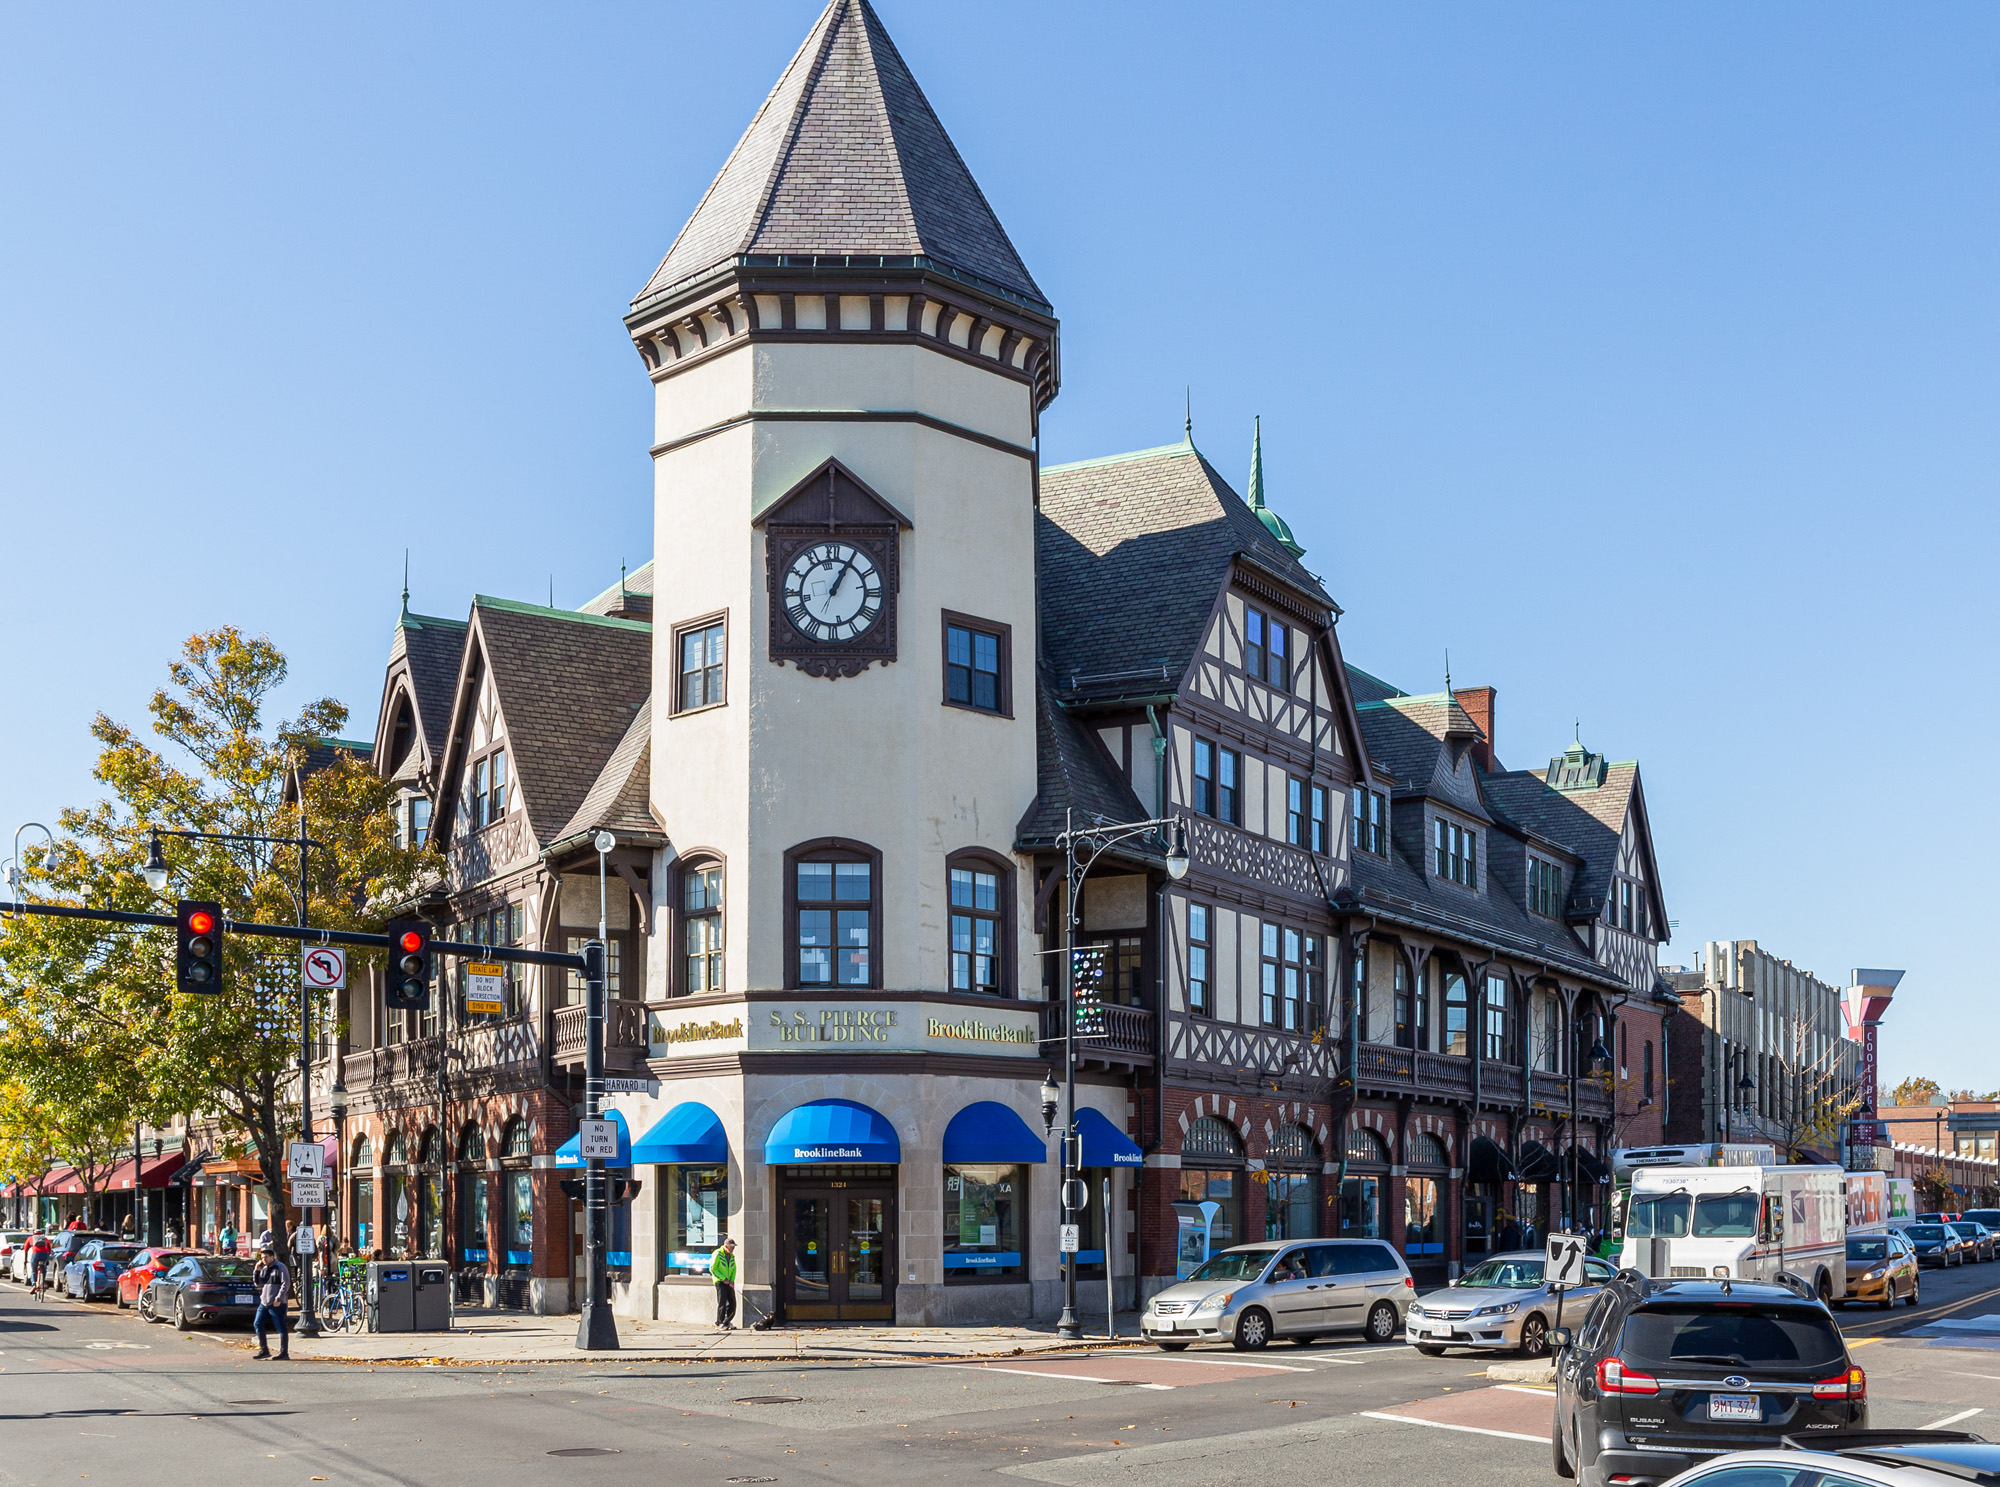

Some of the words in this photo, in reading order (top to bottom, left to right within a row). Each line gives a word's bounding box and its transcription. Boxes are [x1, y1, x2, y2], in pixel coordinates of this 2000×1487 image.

[472, 965, 486, 974] STATE
[470, 992, 500, 1001] INTERSECTION
[769, 1010, 787, 1026] S.
[793, 1010, 811, 1026] S.
[819, 1010, 897, 1026] PIERCE
[652, 1017, 744, 1044] BrooklineBank
[781, 1026, 888, 1042] BUILDING
[928, 1017, 1036, 1044] BrooklineBank
[1866, 1032, 1874, 1110] COOLIDG
[606, 1079, 639, 1091] HARVARD
[594, 1124, 604, 1133] NO
[591, 1135, 608, 1143] TURN
[585, 1145, 595, 1153] ON
[600, 1146, 613, 1154] RED
[794, 1147, 862, 1158] BrooklineBank
[1846, 1176, 1882, 1226] FedEx
[965, 1256, 997, 1264] BrooklineBank
[1713, 1400, 1733, 1413] 9MT
[1737, 1400, 1757, 1414] 377
